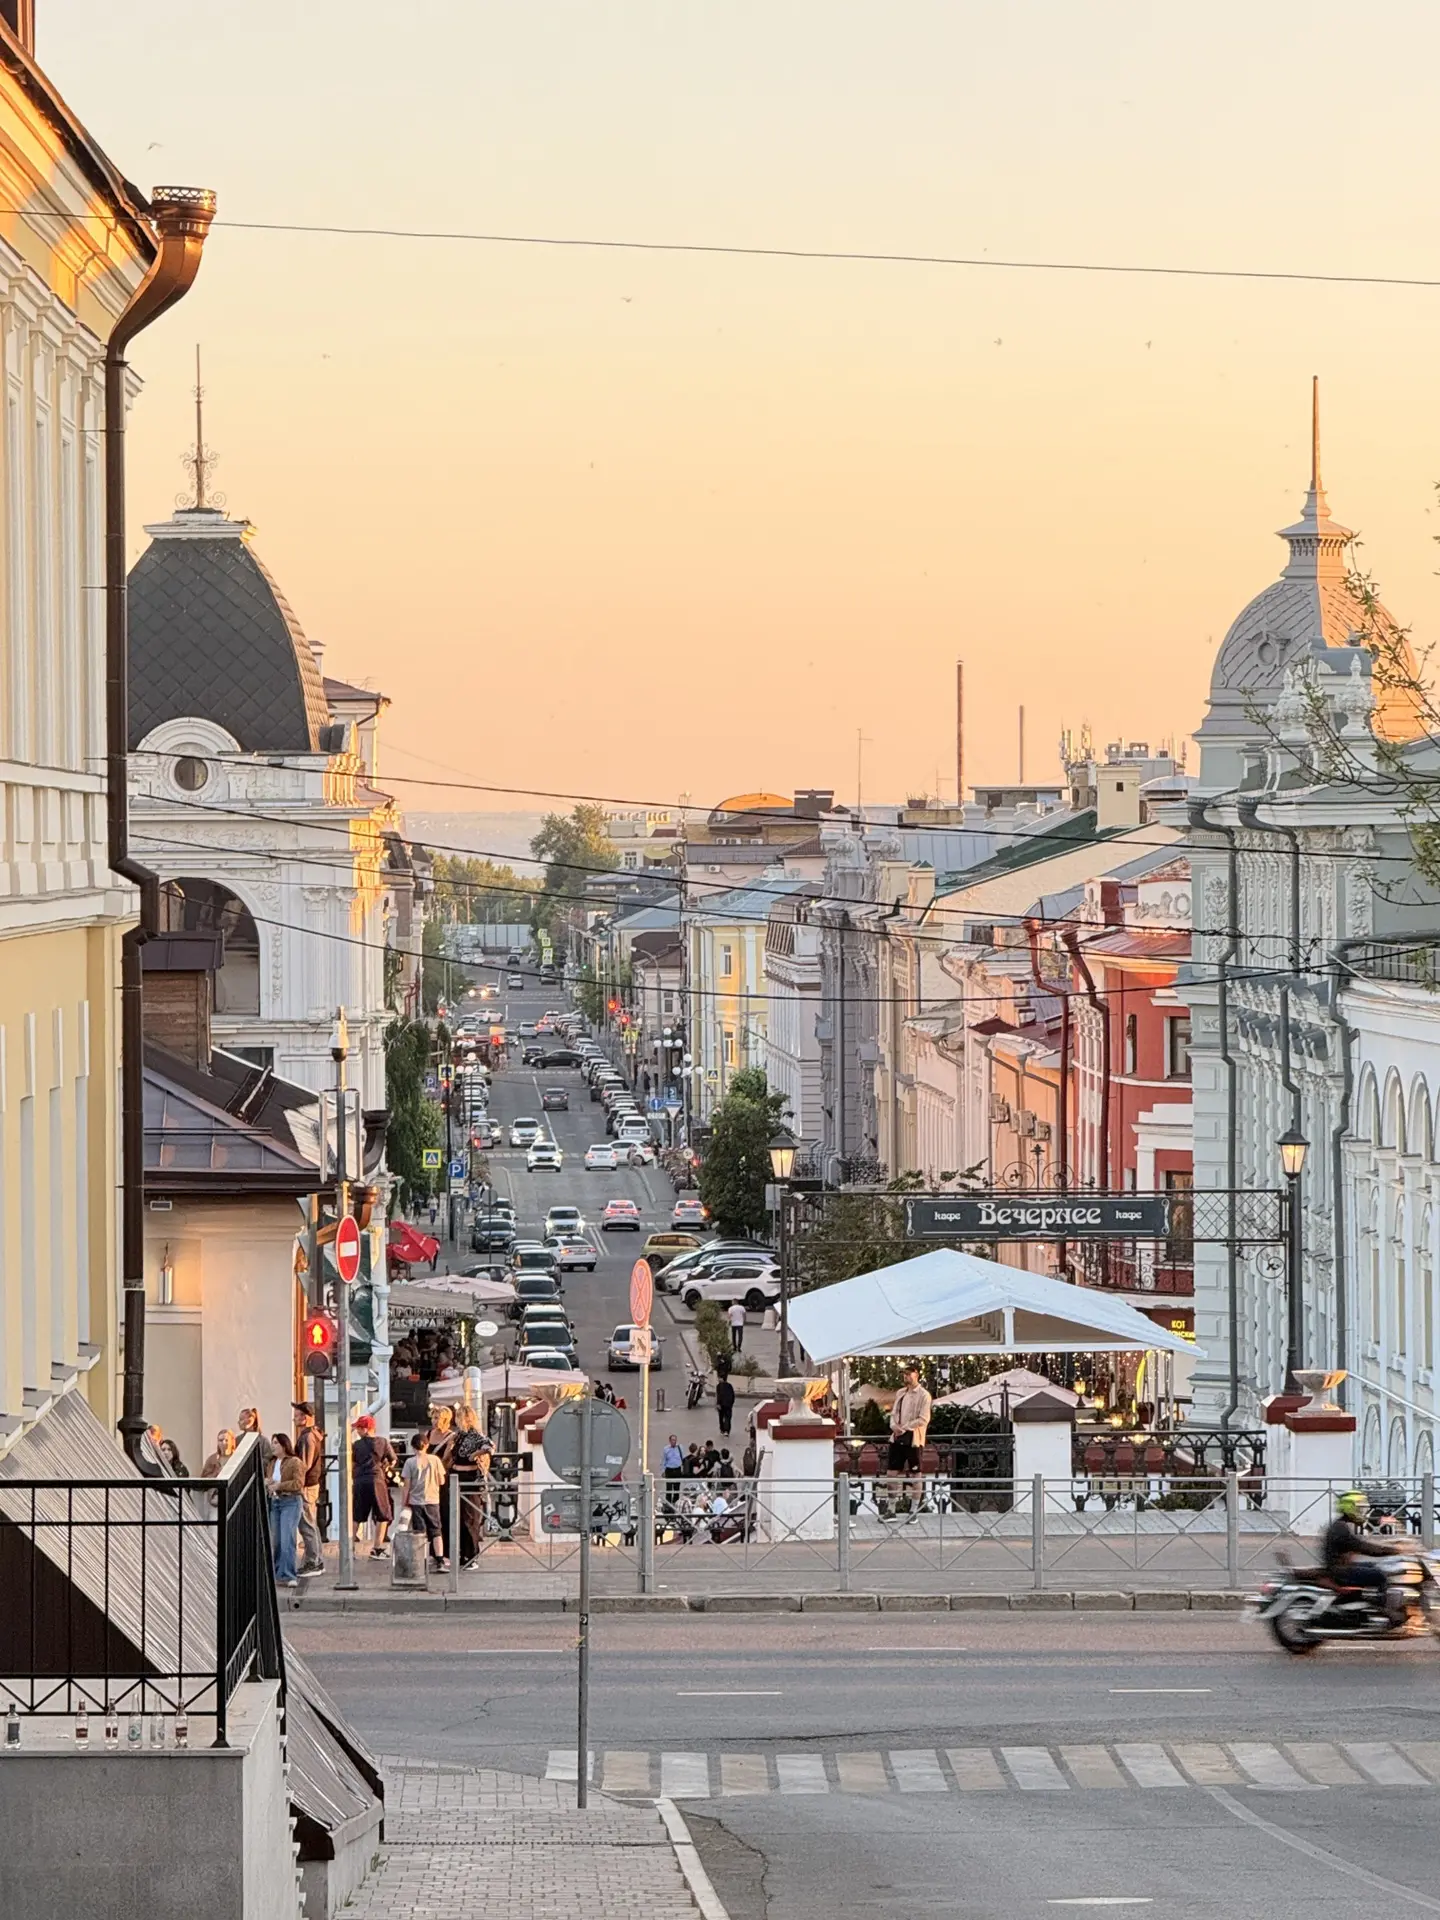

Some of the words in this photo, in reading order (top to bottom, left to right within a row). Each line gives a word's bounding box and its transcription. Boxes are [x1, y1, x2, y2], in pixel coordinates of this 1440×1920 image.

[452, 1164, 461, 1176] P
[934, 1211, 961, 1221] кафе
[977, 1203, 1101, 1229] Вечернее
[1115, 1210, 1142, 1220] кафе
[1171, 1320, 1186, 1329] КОТ
